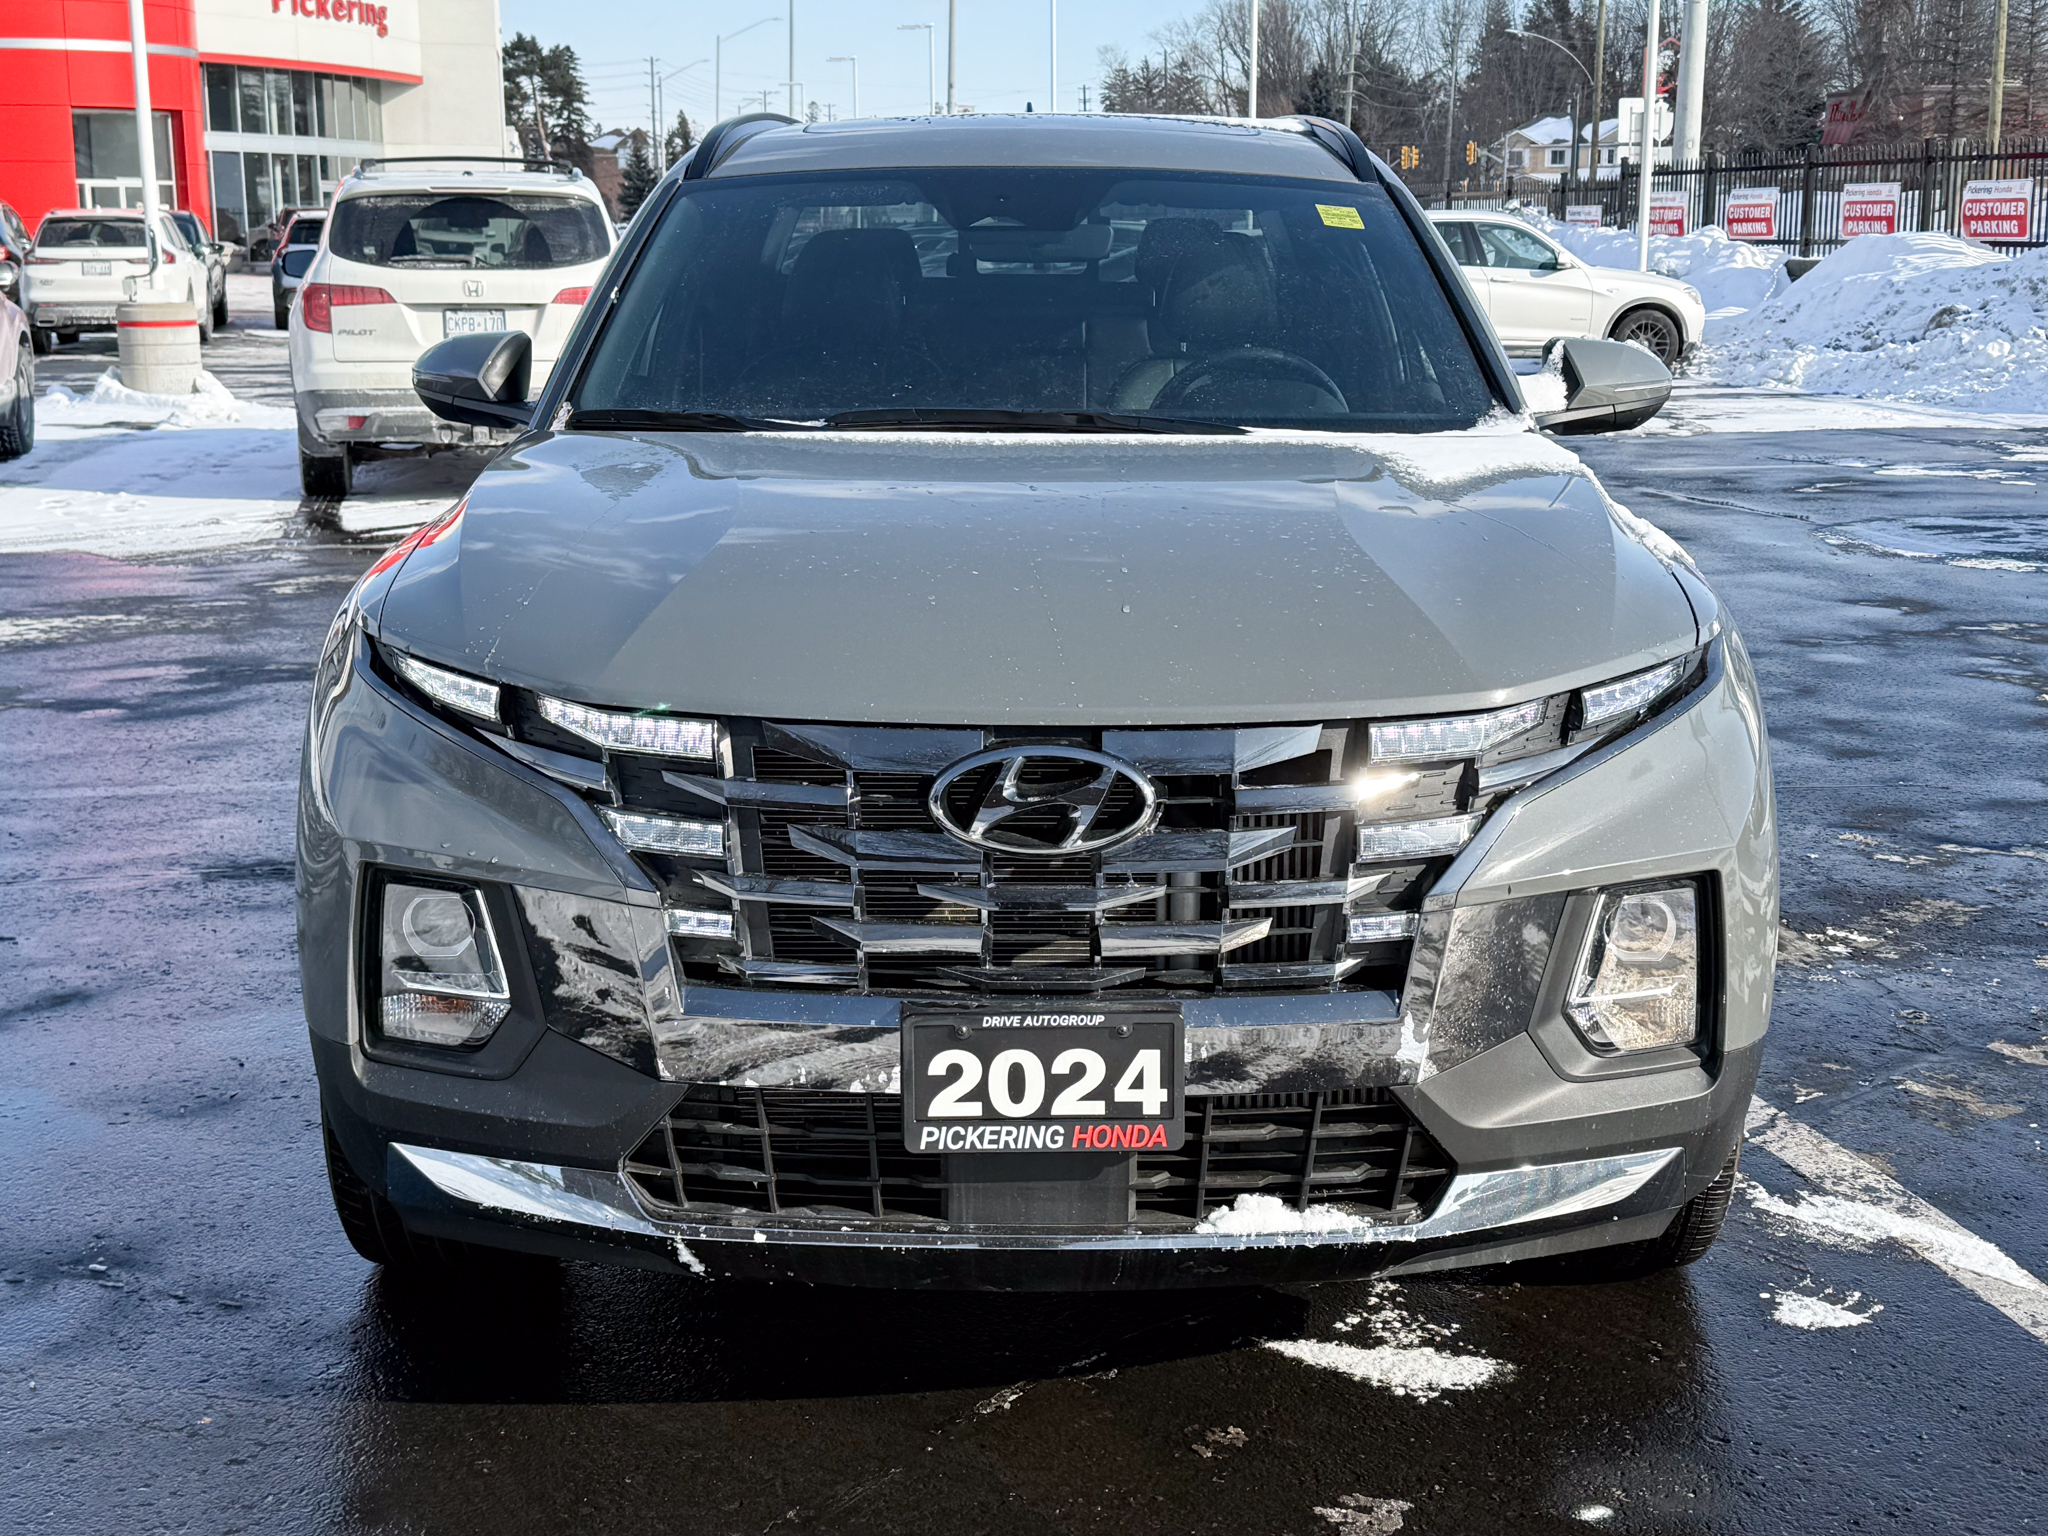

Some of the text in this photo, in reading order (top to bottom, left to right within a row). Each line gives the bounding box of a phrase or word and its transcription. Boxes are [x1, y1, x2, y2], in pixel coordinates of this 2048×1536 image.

[1650, 208, 1682, 221] USTOMER
[1728, 206, 1771, 219] CUSTOMER
[1844, 203, 1893, 217] CUSTOMER
[1965, 201, 2025, 217] CUSTOMER
[1732, 222, 1767, 234] PARKING
[1847, 220, 1888, 234] PARKING
[1970, 220, 2018, 234] PARKING
[982, 1014, 1105, 1027] DRIVE AUTOGROUP
[927, 1048, 1168, 1118] 2024
[919, 1124, 1168, 1150] PICKERING HONDA
